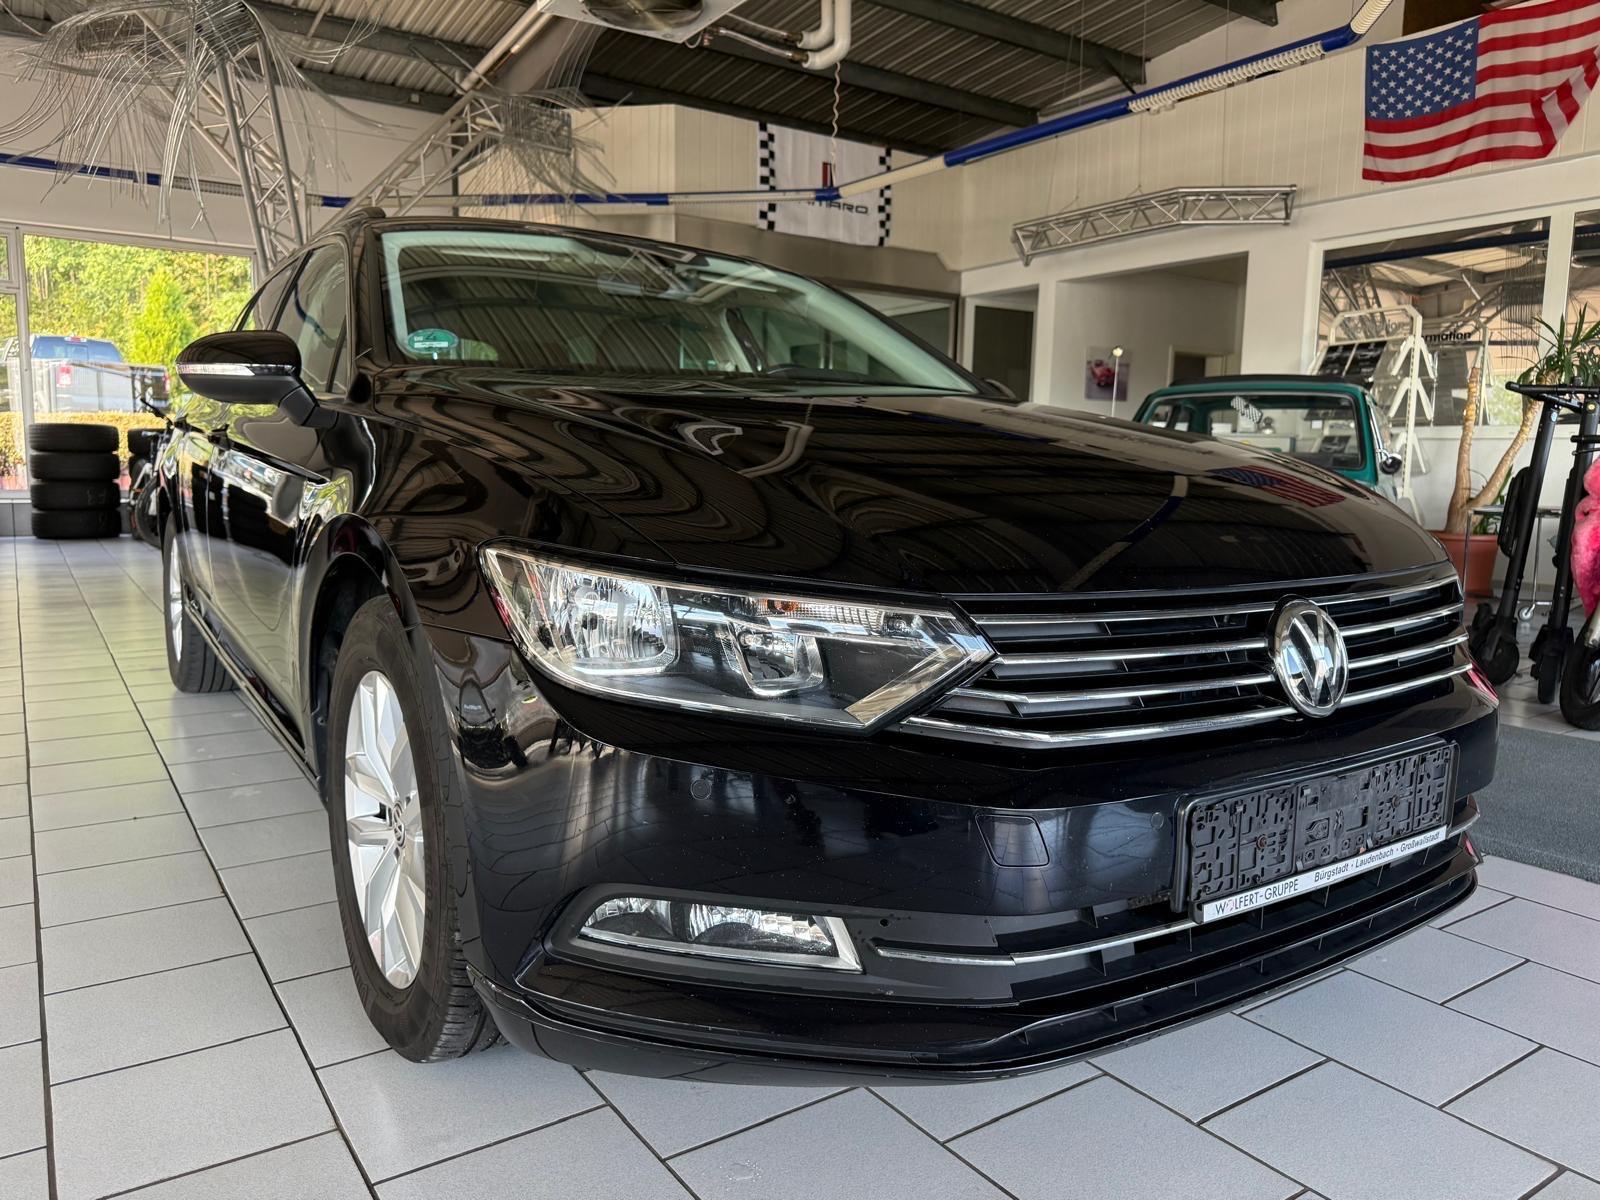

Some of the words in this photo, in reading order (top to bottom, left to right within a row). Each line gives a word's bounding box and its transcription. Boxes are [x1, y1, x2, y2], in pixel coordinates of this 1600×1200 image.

[1215, 878, 1299, 915] WOLFERT-GRUPPE
[1314, 864, 1349, 883] Bürgstadt
[1355, 848, 1394, 869] Laudenbach
[1400, 831, 1440, 853] Großwallstadt
